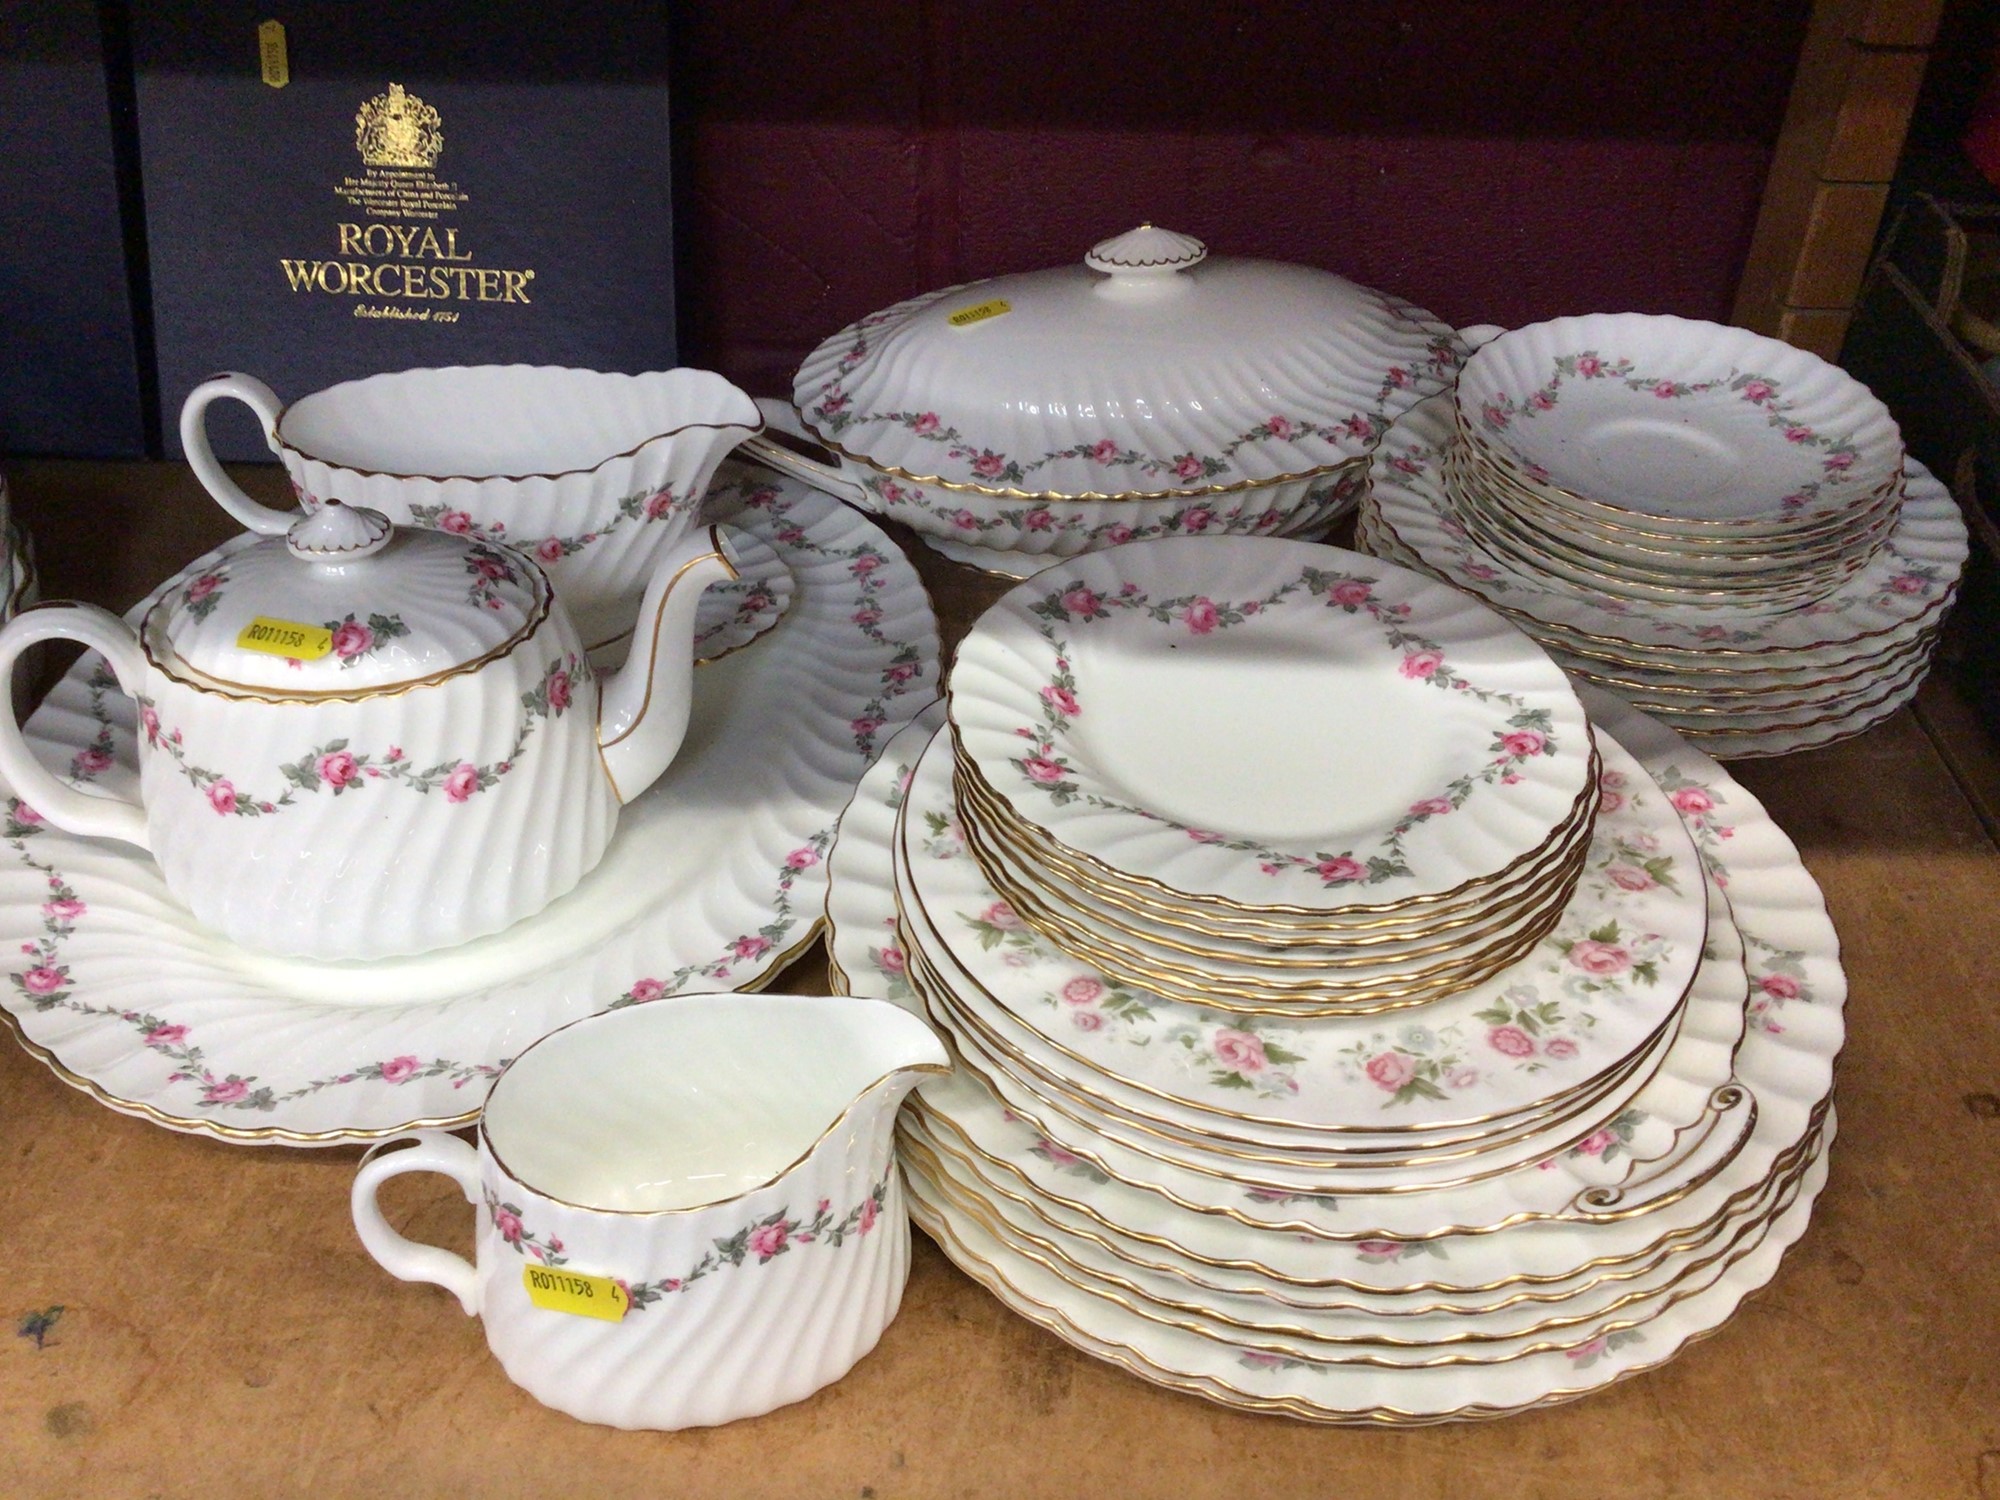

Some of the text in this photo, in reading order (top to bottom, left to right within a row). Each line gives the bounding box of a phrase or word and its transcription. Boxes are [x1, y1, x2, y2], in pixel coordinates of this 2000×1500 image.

[337, 223, 473, 262] ROYAL
[353, 303, 431, 322] Established
[247, 624, 306, 648] R011158
[529, 1269, 620, 1303] R011158 4
